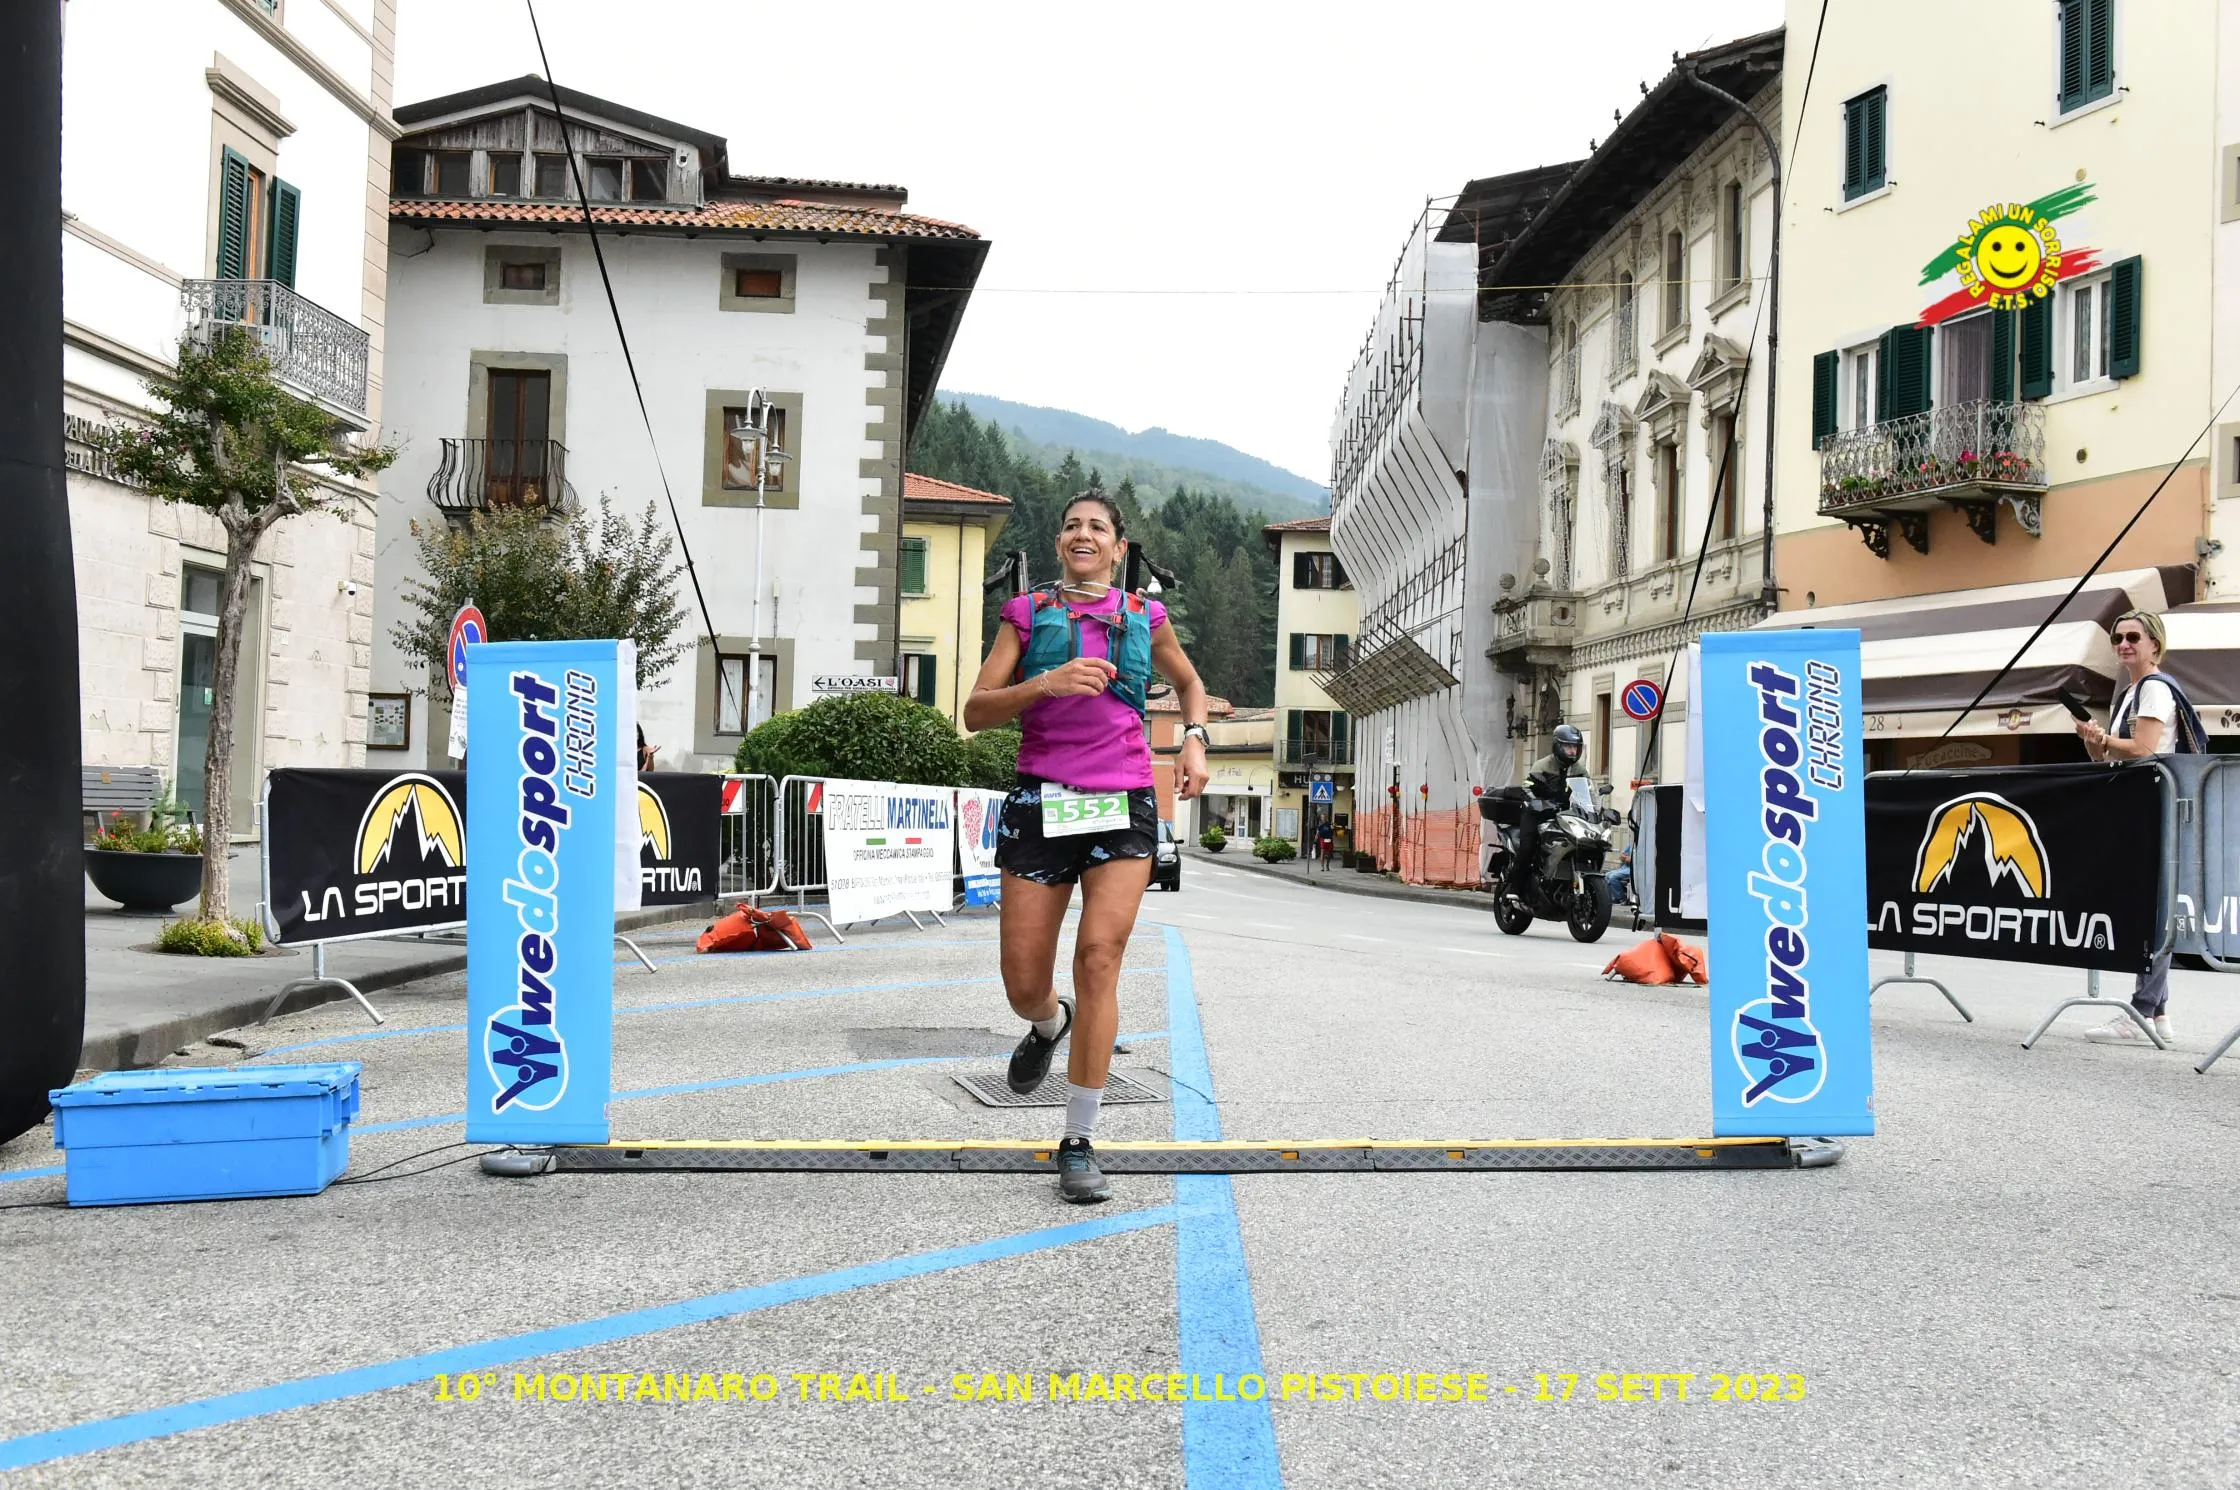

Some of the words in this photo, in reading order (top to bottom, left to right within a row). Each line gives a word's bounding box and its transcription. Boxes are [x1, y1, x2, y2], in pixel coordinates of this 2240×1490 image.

[828, 678, 882, 687] L'OASI
[1869, 715, 1885, 732] 28
[1294, 775, 1310, 784] HU
[829, 793, 885, 830] FRATELLI
[1063, 797, 1122, 823] 552
[503, 672, 570, 1026] wedosport
[564, 670, 597, 798] CHRONO
[1748, 662, 1817, 1019] wedosport
[1806, 660, 1843, 790] CHRONO
[642, 867, 702, 893] RTIVA
[302, 886, 346, 922] LA
[355, 876, 467, 916] SPORT
[1668, 887, 1683, 914] L
[1868, 901, 1902, 933] A
[1912, 902, 2115, 951] SPORTIVA
